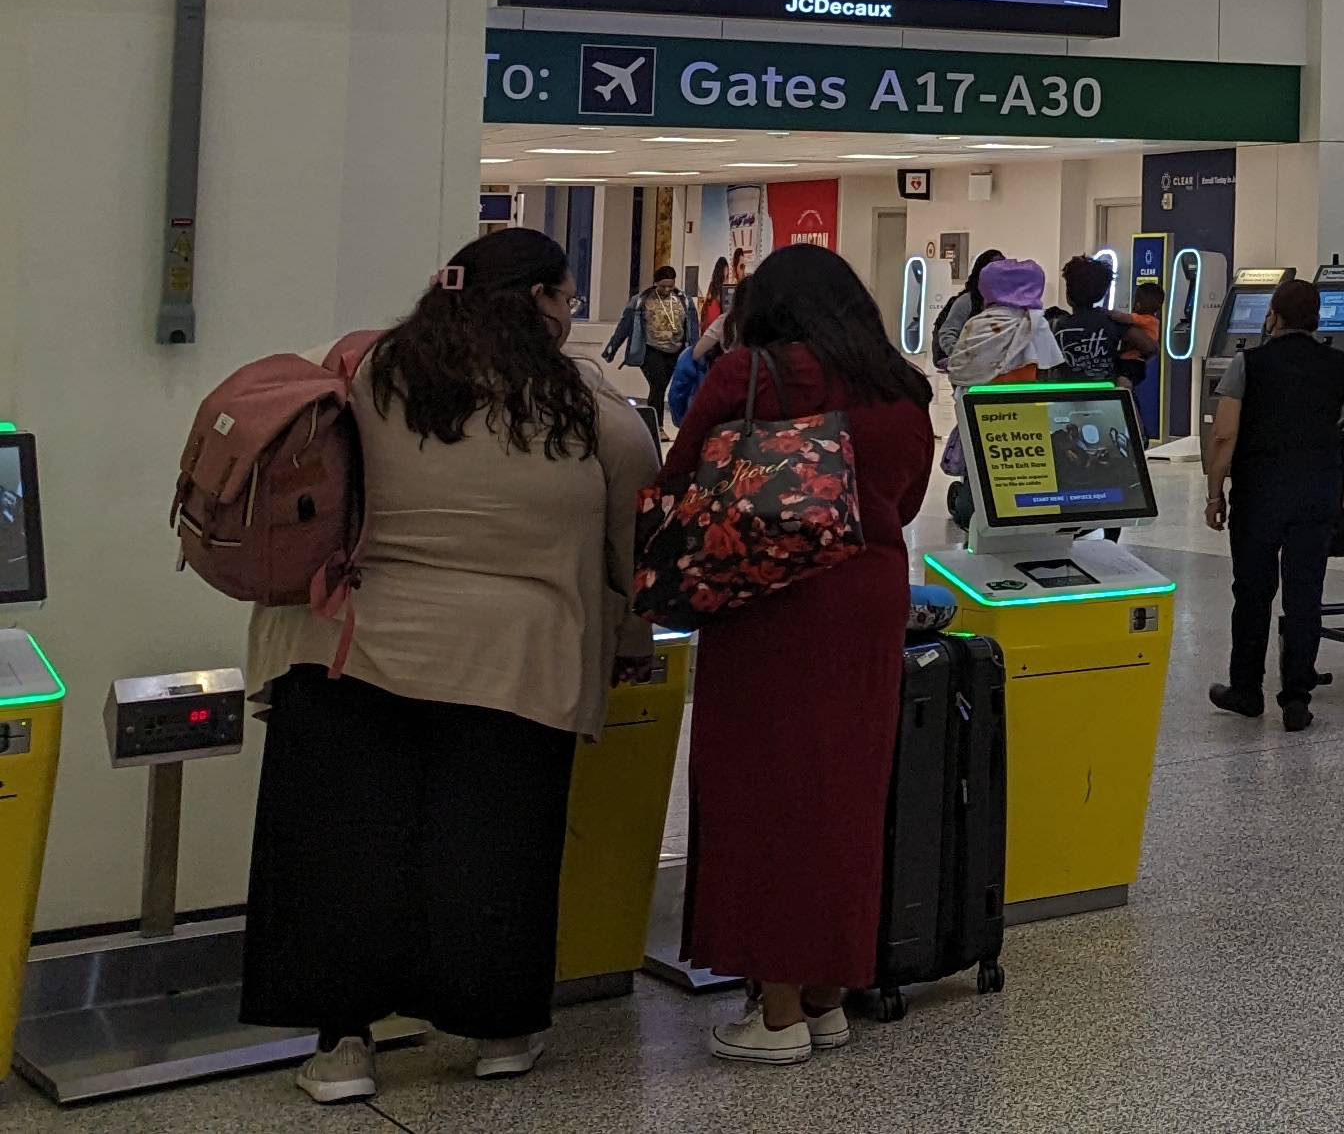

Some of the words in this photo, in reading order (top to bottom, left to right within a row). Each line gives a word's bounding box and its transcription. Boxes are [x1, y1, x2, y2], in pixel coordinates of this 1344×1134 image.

[680, 60, 847, 112] Gates
[869, 67, 1102, 119] A17-A30
[1173, 177, 1193, 185] CLEAR
[981, 412, 1018, 422] spirit
[986, 432, 1008, 442] Get
[1011, 432, 1042, 441] More
[989, 445, 1045, 461] Space
